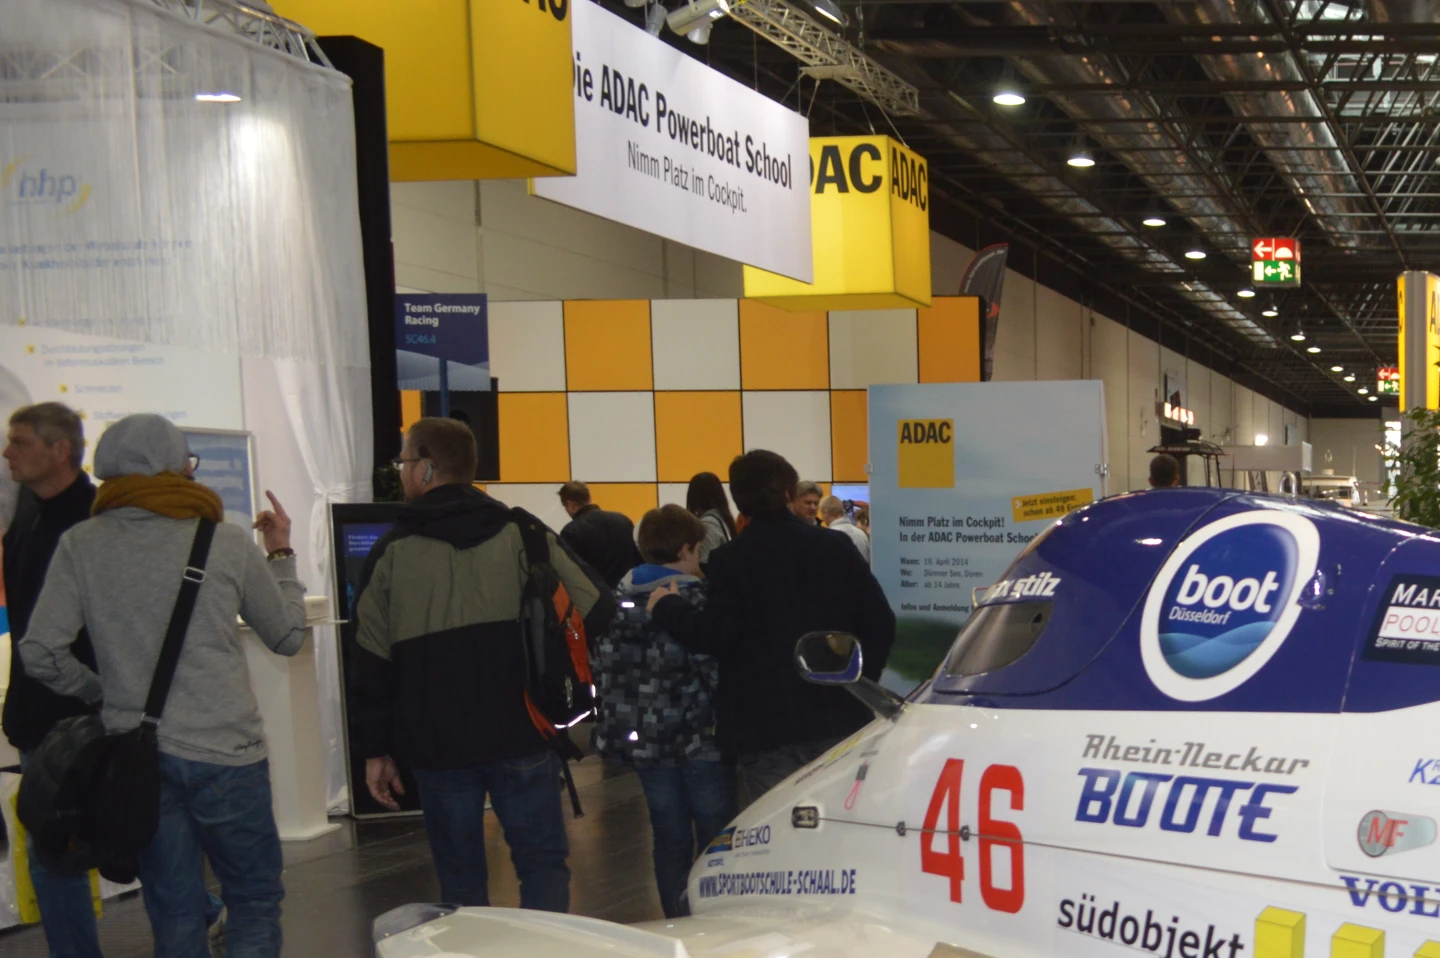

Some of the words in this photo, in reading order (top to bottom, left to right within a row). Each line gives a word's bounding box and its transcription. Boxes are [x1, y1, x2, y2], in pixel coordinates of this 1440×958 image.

[573, 51, 593, 102] ie
[600, 64, 650, 127] ADAC
[656, 91, 741, 169] Powerboat
[746, 135, 792, 190] School
[628, 140, 660, 179] Nimm
[664, 156, 689, 190] Platz
[692, 168, 705, 196] im
[708, 175, 747, 214] Cockpit.
[809, 143, 883, 194] AC
[892, 147, 927, 212] ADAC
[404, 303, 433, 313] Team
[434, 303, 480, 315] Germany
[404, 315, 439, 327] Racing
[900, 421, 952, 444] ADAC
[899, 517, 925, 527] Nimm
[927, 517, 950, 527] Platz
[952, 517, 964, 527] im
[966, 517, 1005, 529] Cockpit!
[899, 533, 908, 542] In
[911, 532, 925, 542] der
[928, 533, 953, 542] ADAC
[956, 533, 1004, 542] Powerboat
[936, 558, 950, 567] April
[951, 558, 969, 566] 2014
[934, 580, 943, 588] 14
[944, 580, 960, 588] Jahre
[1010, 572, 1061, 598] stilz
[1176, 563, 1280, 614] boot
[901, 602, 917, 610] Infos
[918, 603, 931, 611] und
[932, 603, 970, 613] Anmeldung
[1168, 605, 1231, 626] Düsseldorf
[1375, 637, 1405, 649] SPIRIT
[1407, 639, 1420, 650] OF
[1422, 641, 1440, 651] THE
[1082, 734, 1310, 776] Rhein-Neckar
[1075, 767, 1300, 843] BOOTE
[921, 758, 1025, 914] 46
